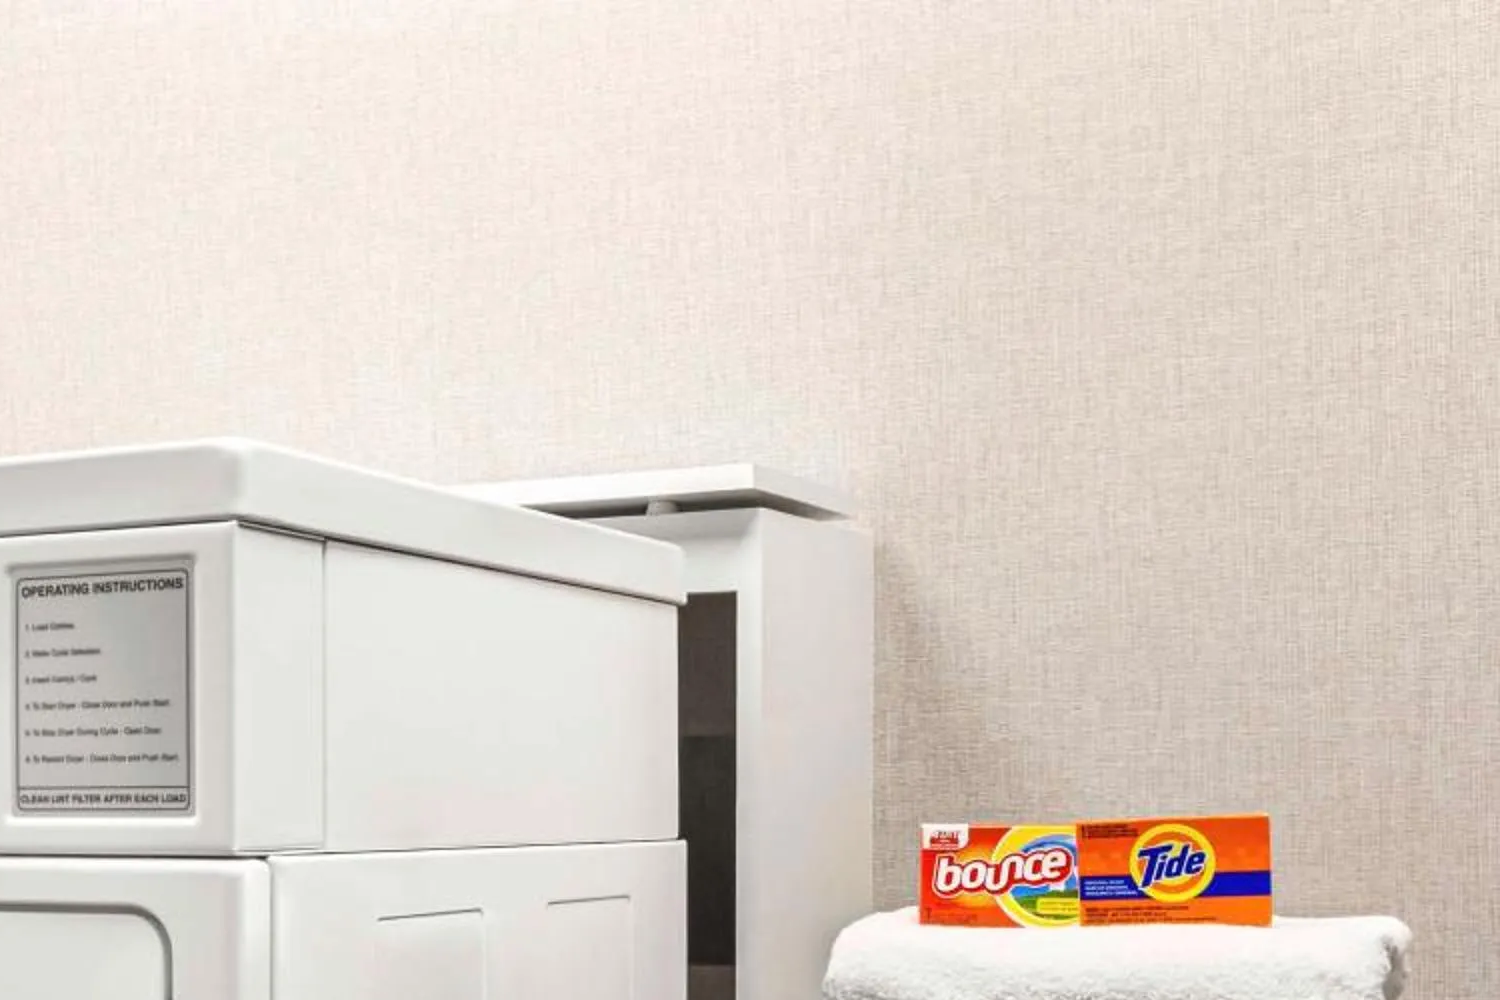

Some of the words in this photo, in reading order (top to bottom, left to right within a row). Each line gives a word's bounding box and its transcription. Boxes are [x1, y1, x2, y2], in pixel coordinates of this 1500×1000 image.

[21, 583, 89, 599] OPERATING
[93, 577, 184, 594] INSTRUCTIONS
[51, 794, 70, 804] LINT
[72, 794, 100, 804] FILTER
[104, 793, 133, 804] AFTER
[134, 793, 159, 803] EACH
[161, 792, 187, 804] LOAD
[936, 850, 1067, 892] bounce
[1137, 843, 1207, 890] Tide
